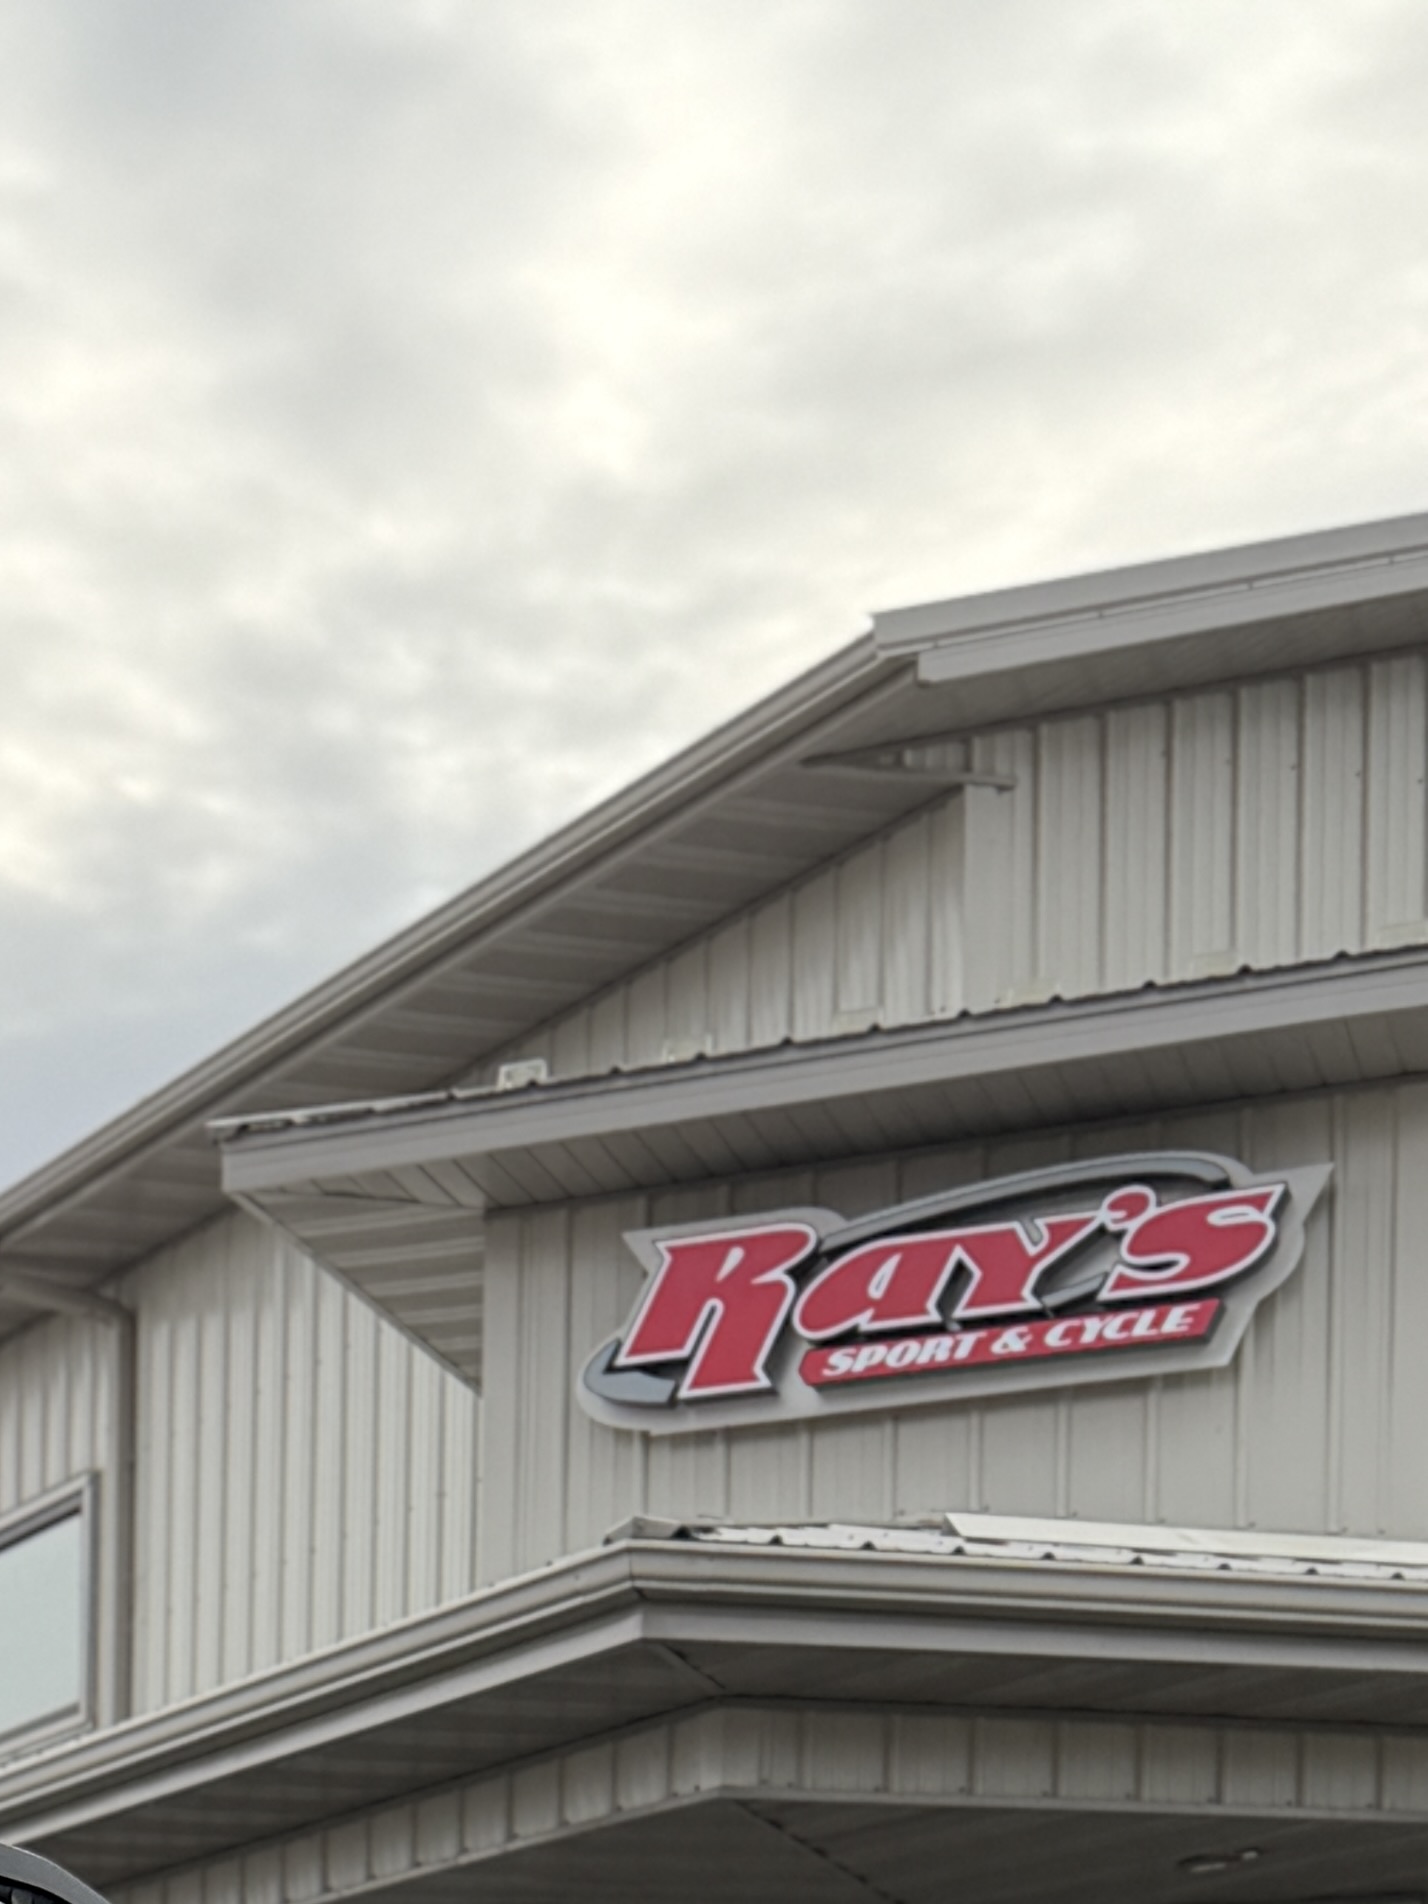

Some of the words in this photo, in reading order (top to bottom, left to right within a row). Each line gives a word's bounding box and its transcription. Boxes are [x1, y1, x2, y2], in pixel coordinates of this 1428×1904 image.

[821, 1331, 985, 1379] SPORT
[989, 1326, 1034, 1355] &
[1044, 1304, 1201, 1348] CYCLE
